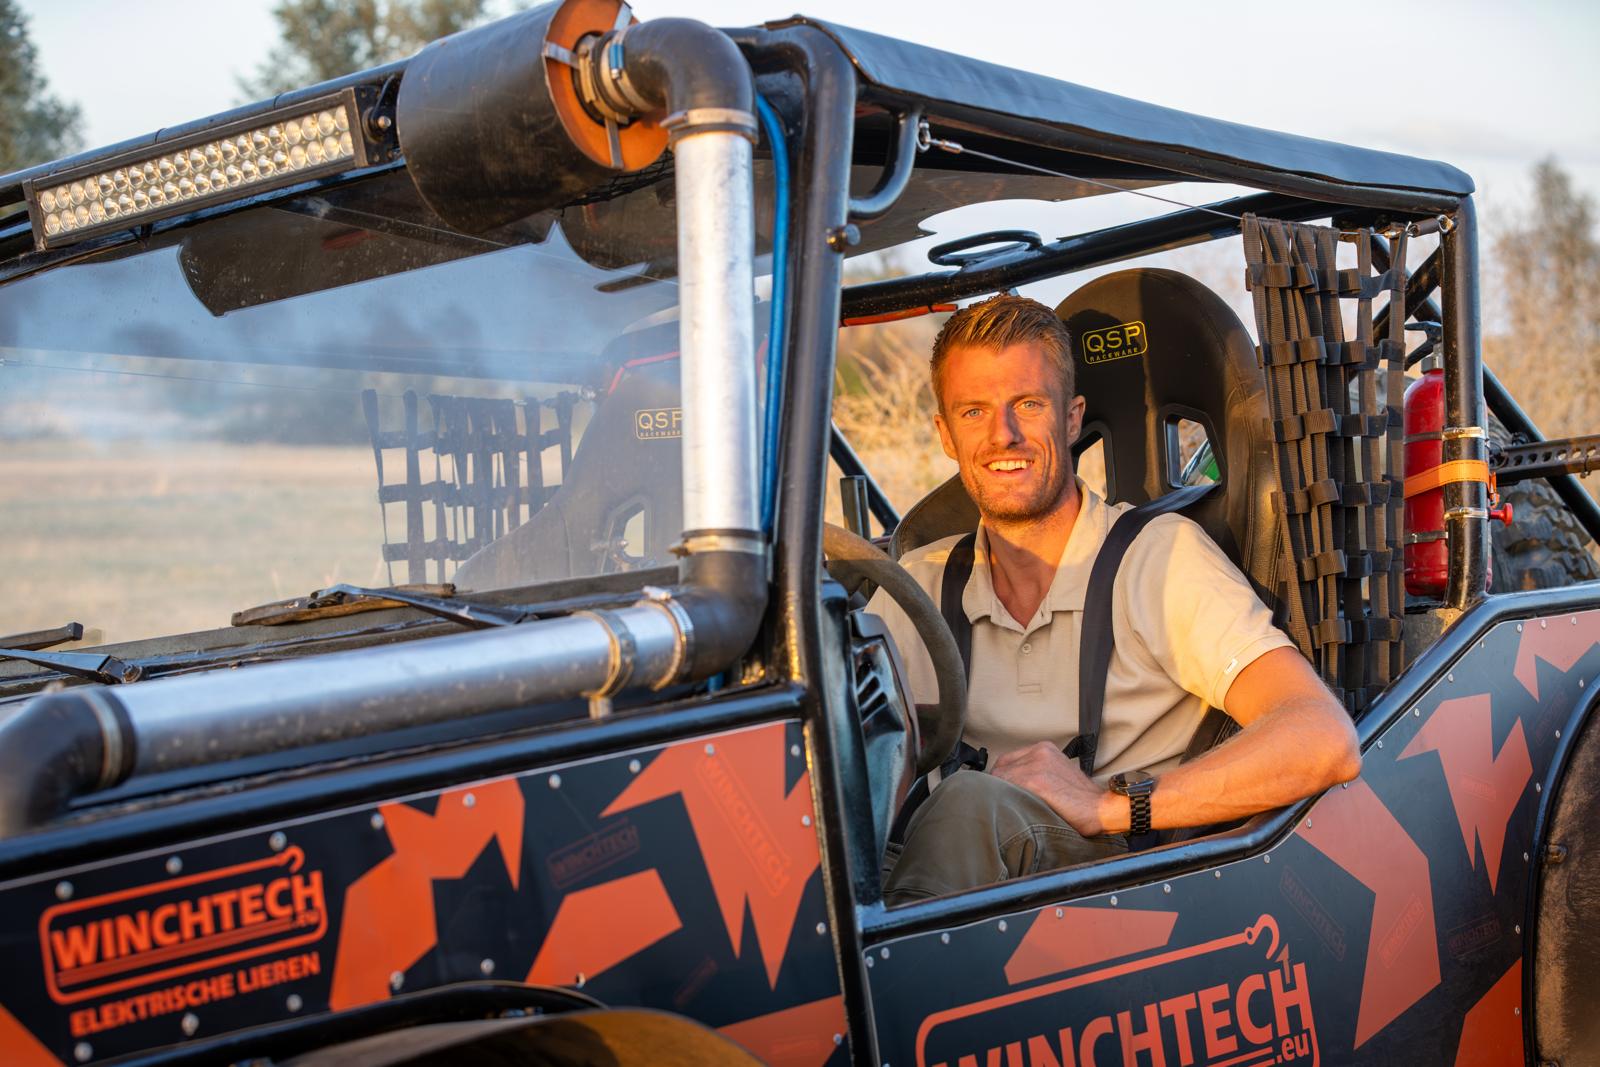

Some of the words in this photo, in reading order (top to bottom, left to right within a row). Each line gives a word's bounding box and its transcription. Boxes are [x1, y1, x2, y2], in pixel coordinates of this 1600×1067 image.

[1086, 325, 1141, 353] QSP
[1089, 347, 1138, 362] RACEWARE
[51, 870, 323, 970] WINCHTECH
[70, 973, 236, 1038] ELEKTRISCHE
[236, 951, 321, 994] LIEREN
[1276, 1032, 1310, 1064] .eu
